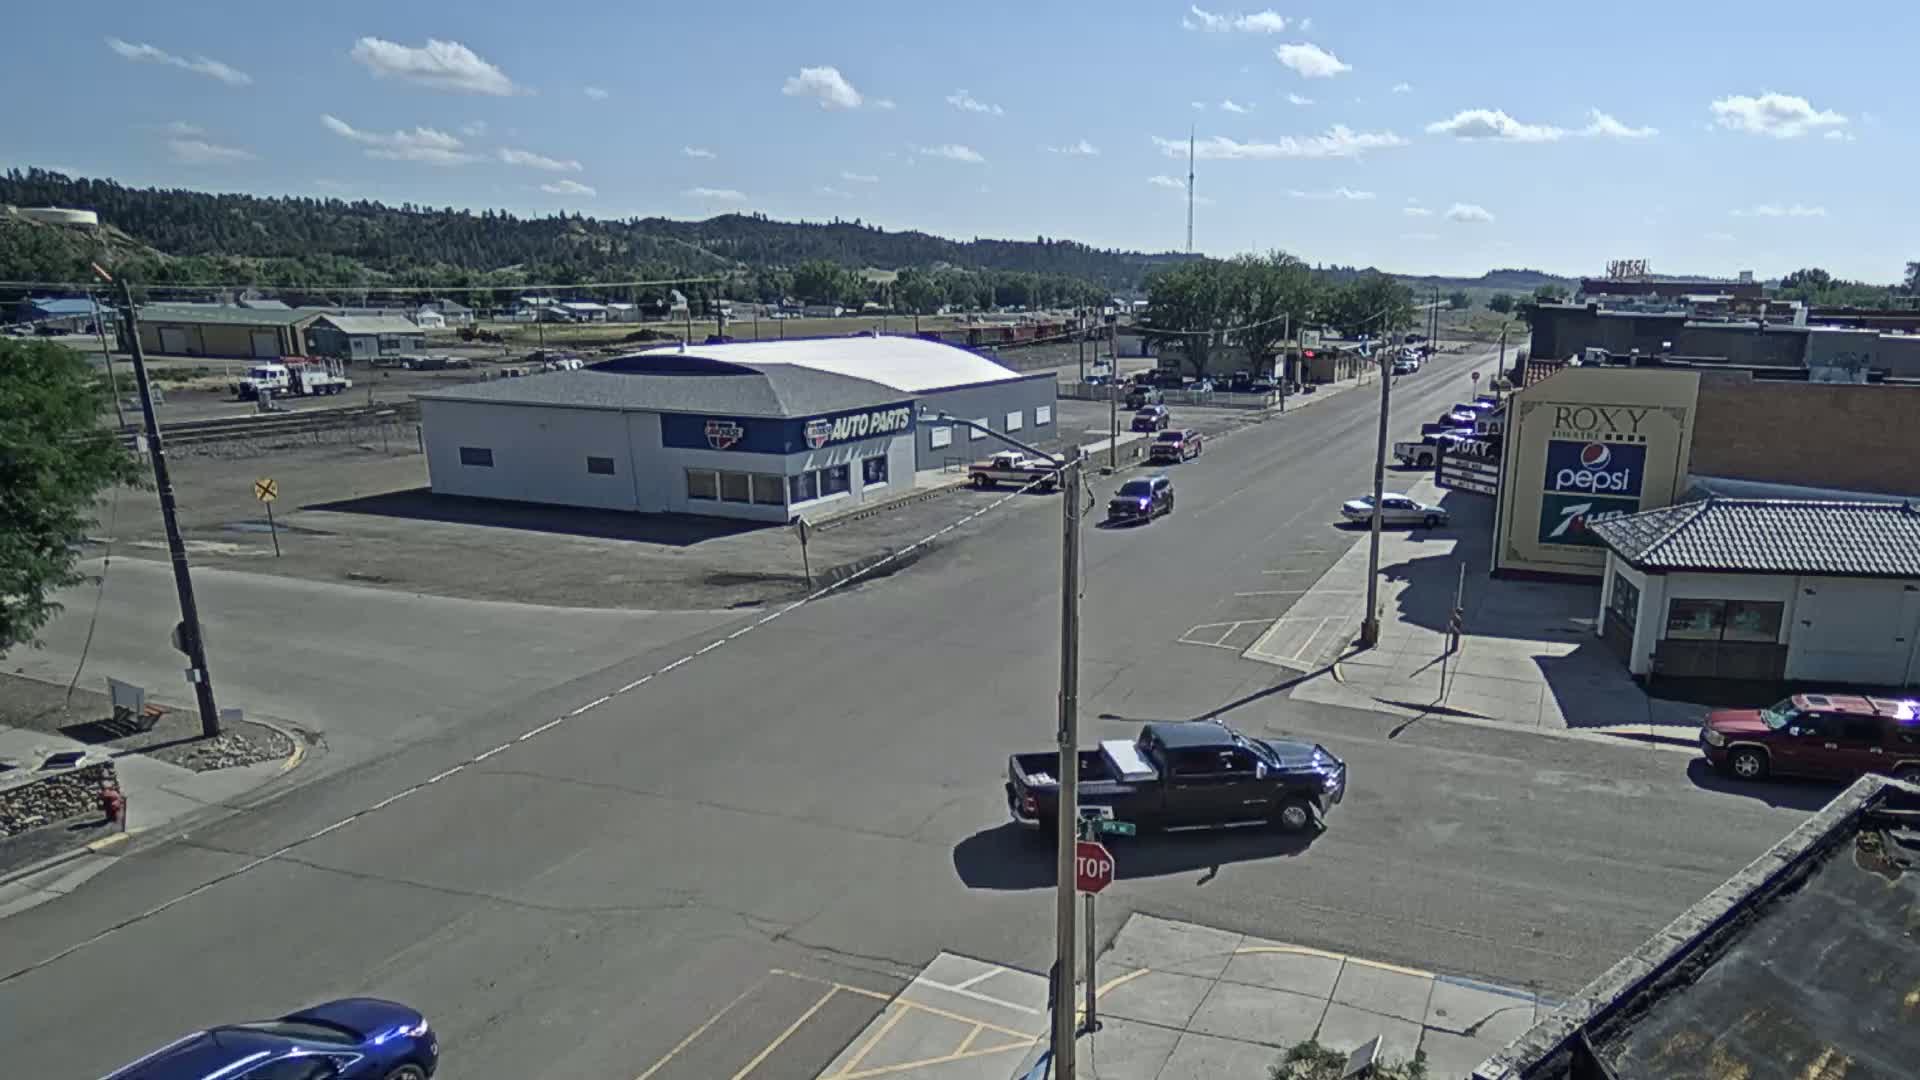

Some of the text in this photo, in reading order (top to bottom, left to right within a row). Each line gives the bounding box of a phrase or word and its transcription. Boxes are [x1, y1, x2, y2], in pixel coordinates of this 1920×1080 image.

[831, 407, 910, 441] AUTO PARTS
[1555, 406, 1648, 432] ROXY
[1556, 468, 1630, 493] pepsi
[1077, 857, 1110, 879] TOP
